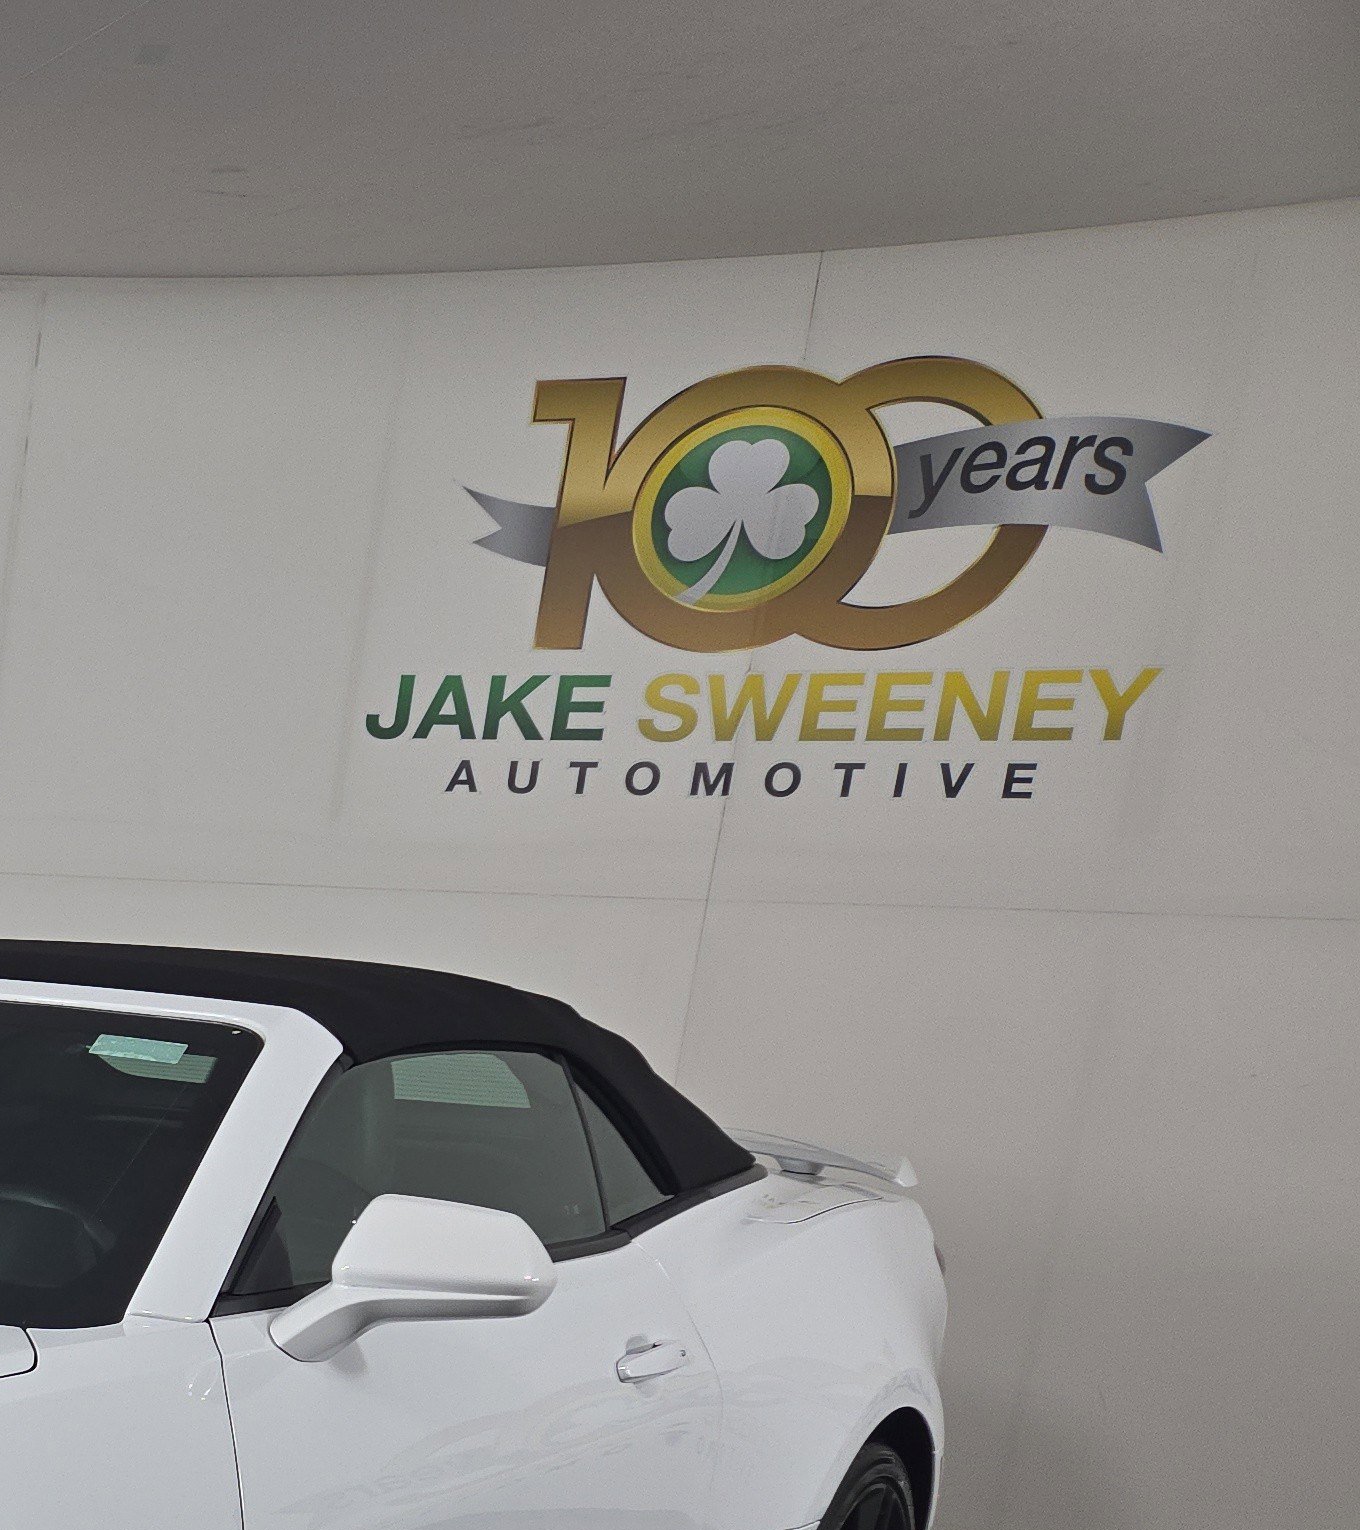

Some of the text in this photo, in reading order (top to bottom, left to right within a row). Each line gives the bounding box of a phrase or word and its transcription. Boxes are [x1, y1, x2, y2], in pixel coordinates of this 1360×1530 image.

[531, 355, 1136, 653] 100 years
[365, 667, 1162, 742] JAKE SWEENEY
[445, 761, 1038, 800] AUTOMOTIVE
